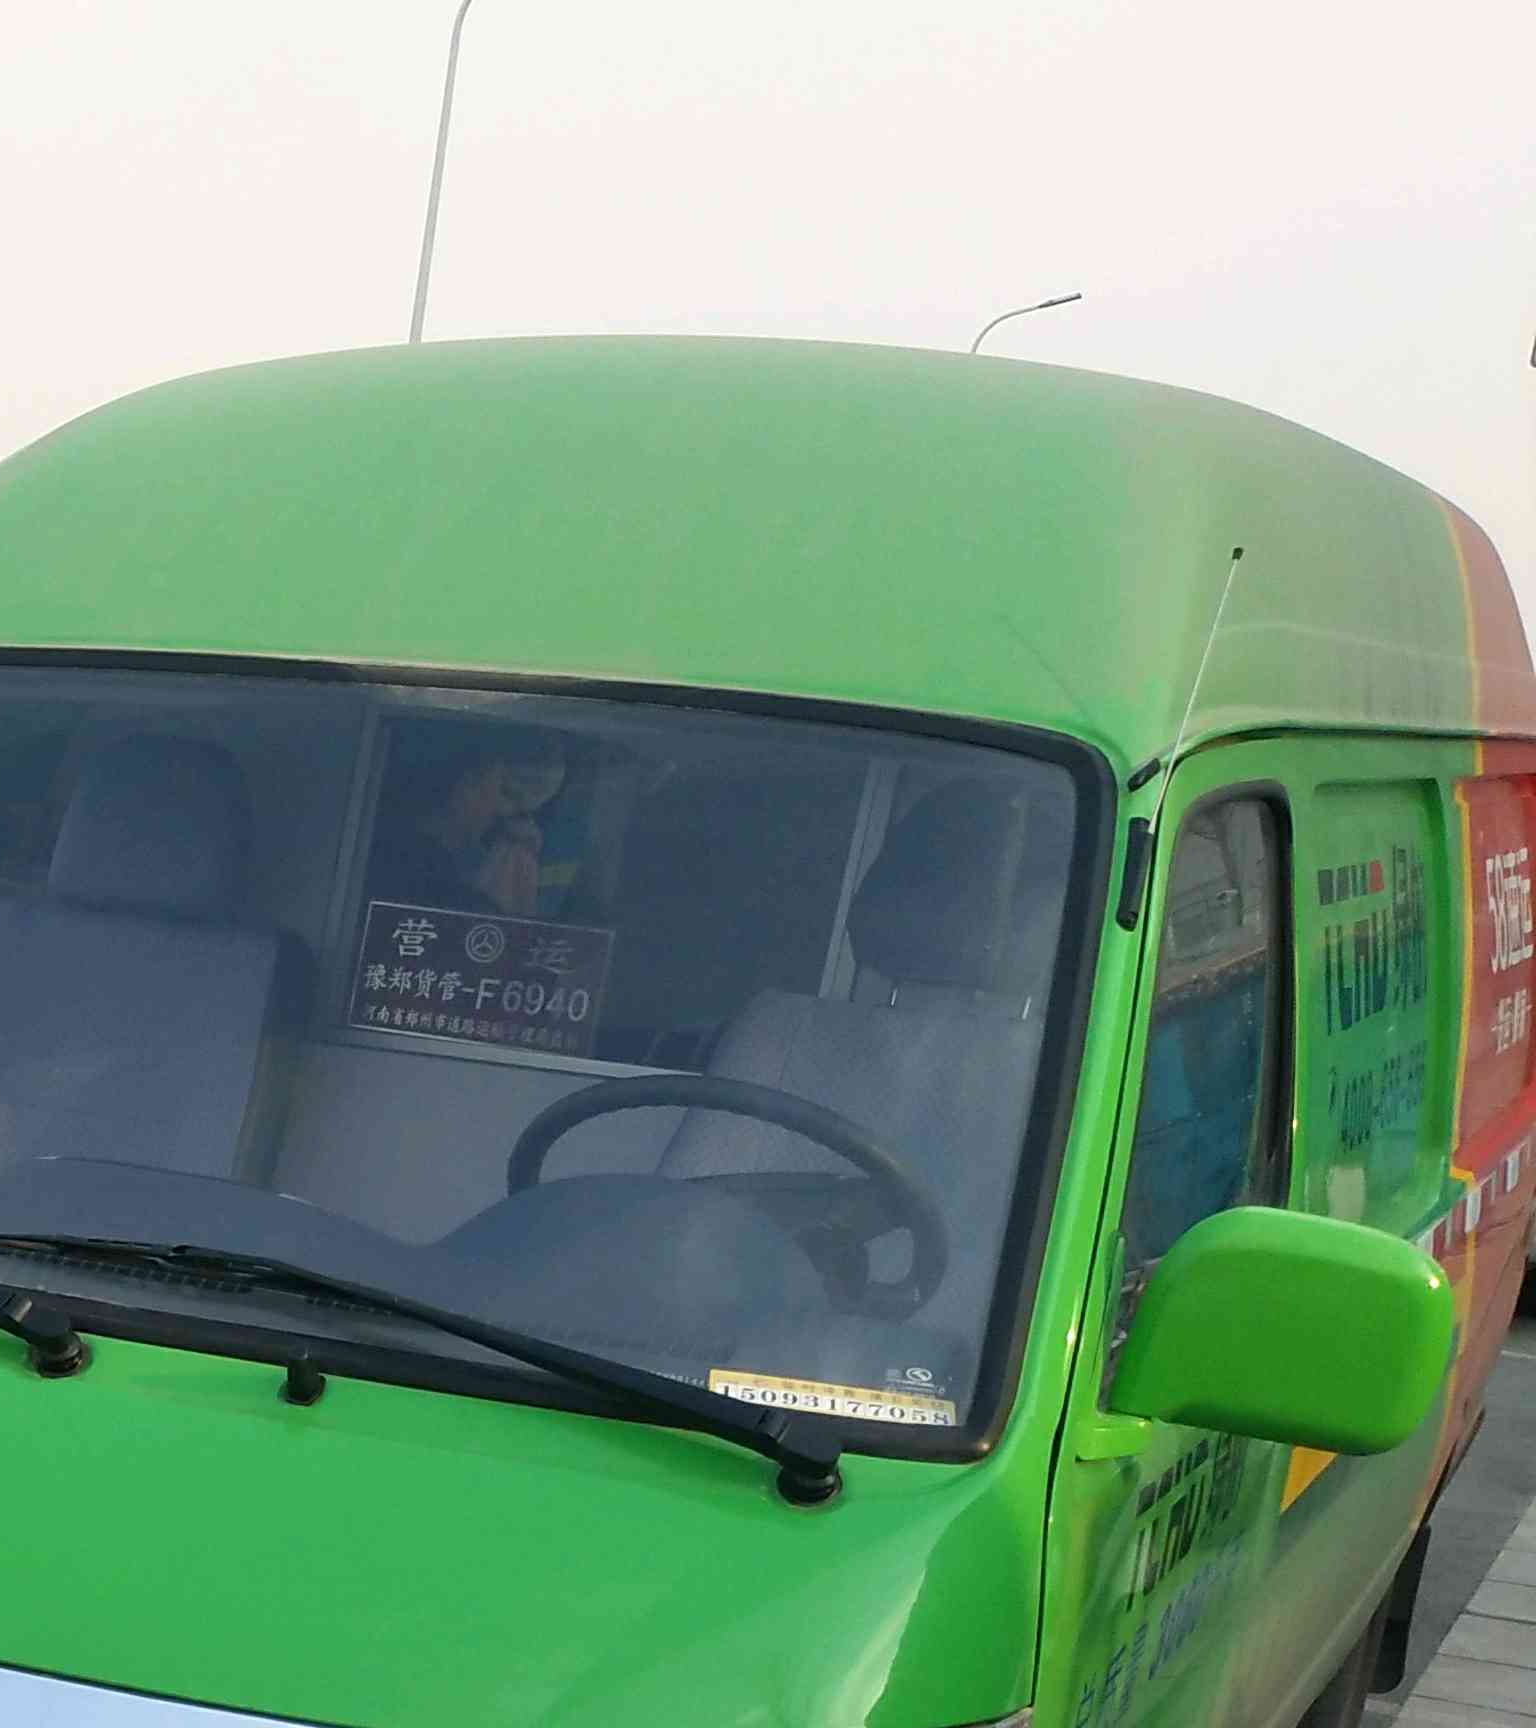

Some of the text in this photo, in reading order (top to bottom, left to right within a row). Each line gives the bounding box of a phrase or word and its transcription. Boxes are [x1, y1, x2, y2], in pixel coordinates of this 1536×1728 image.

[392, 918, 576, 975] 营 运
[722, 1385, 949, 1424] 15093177058
